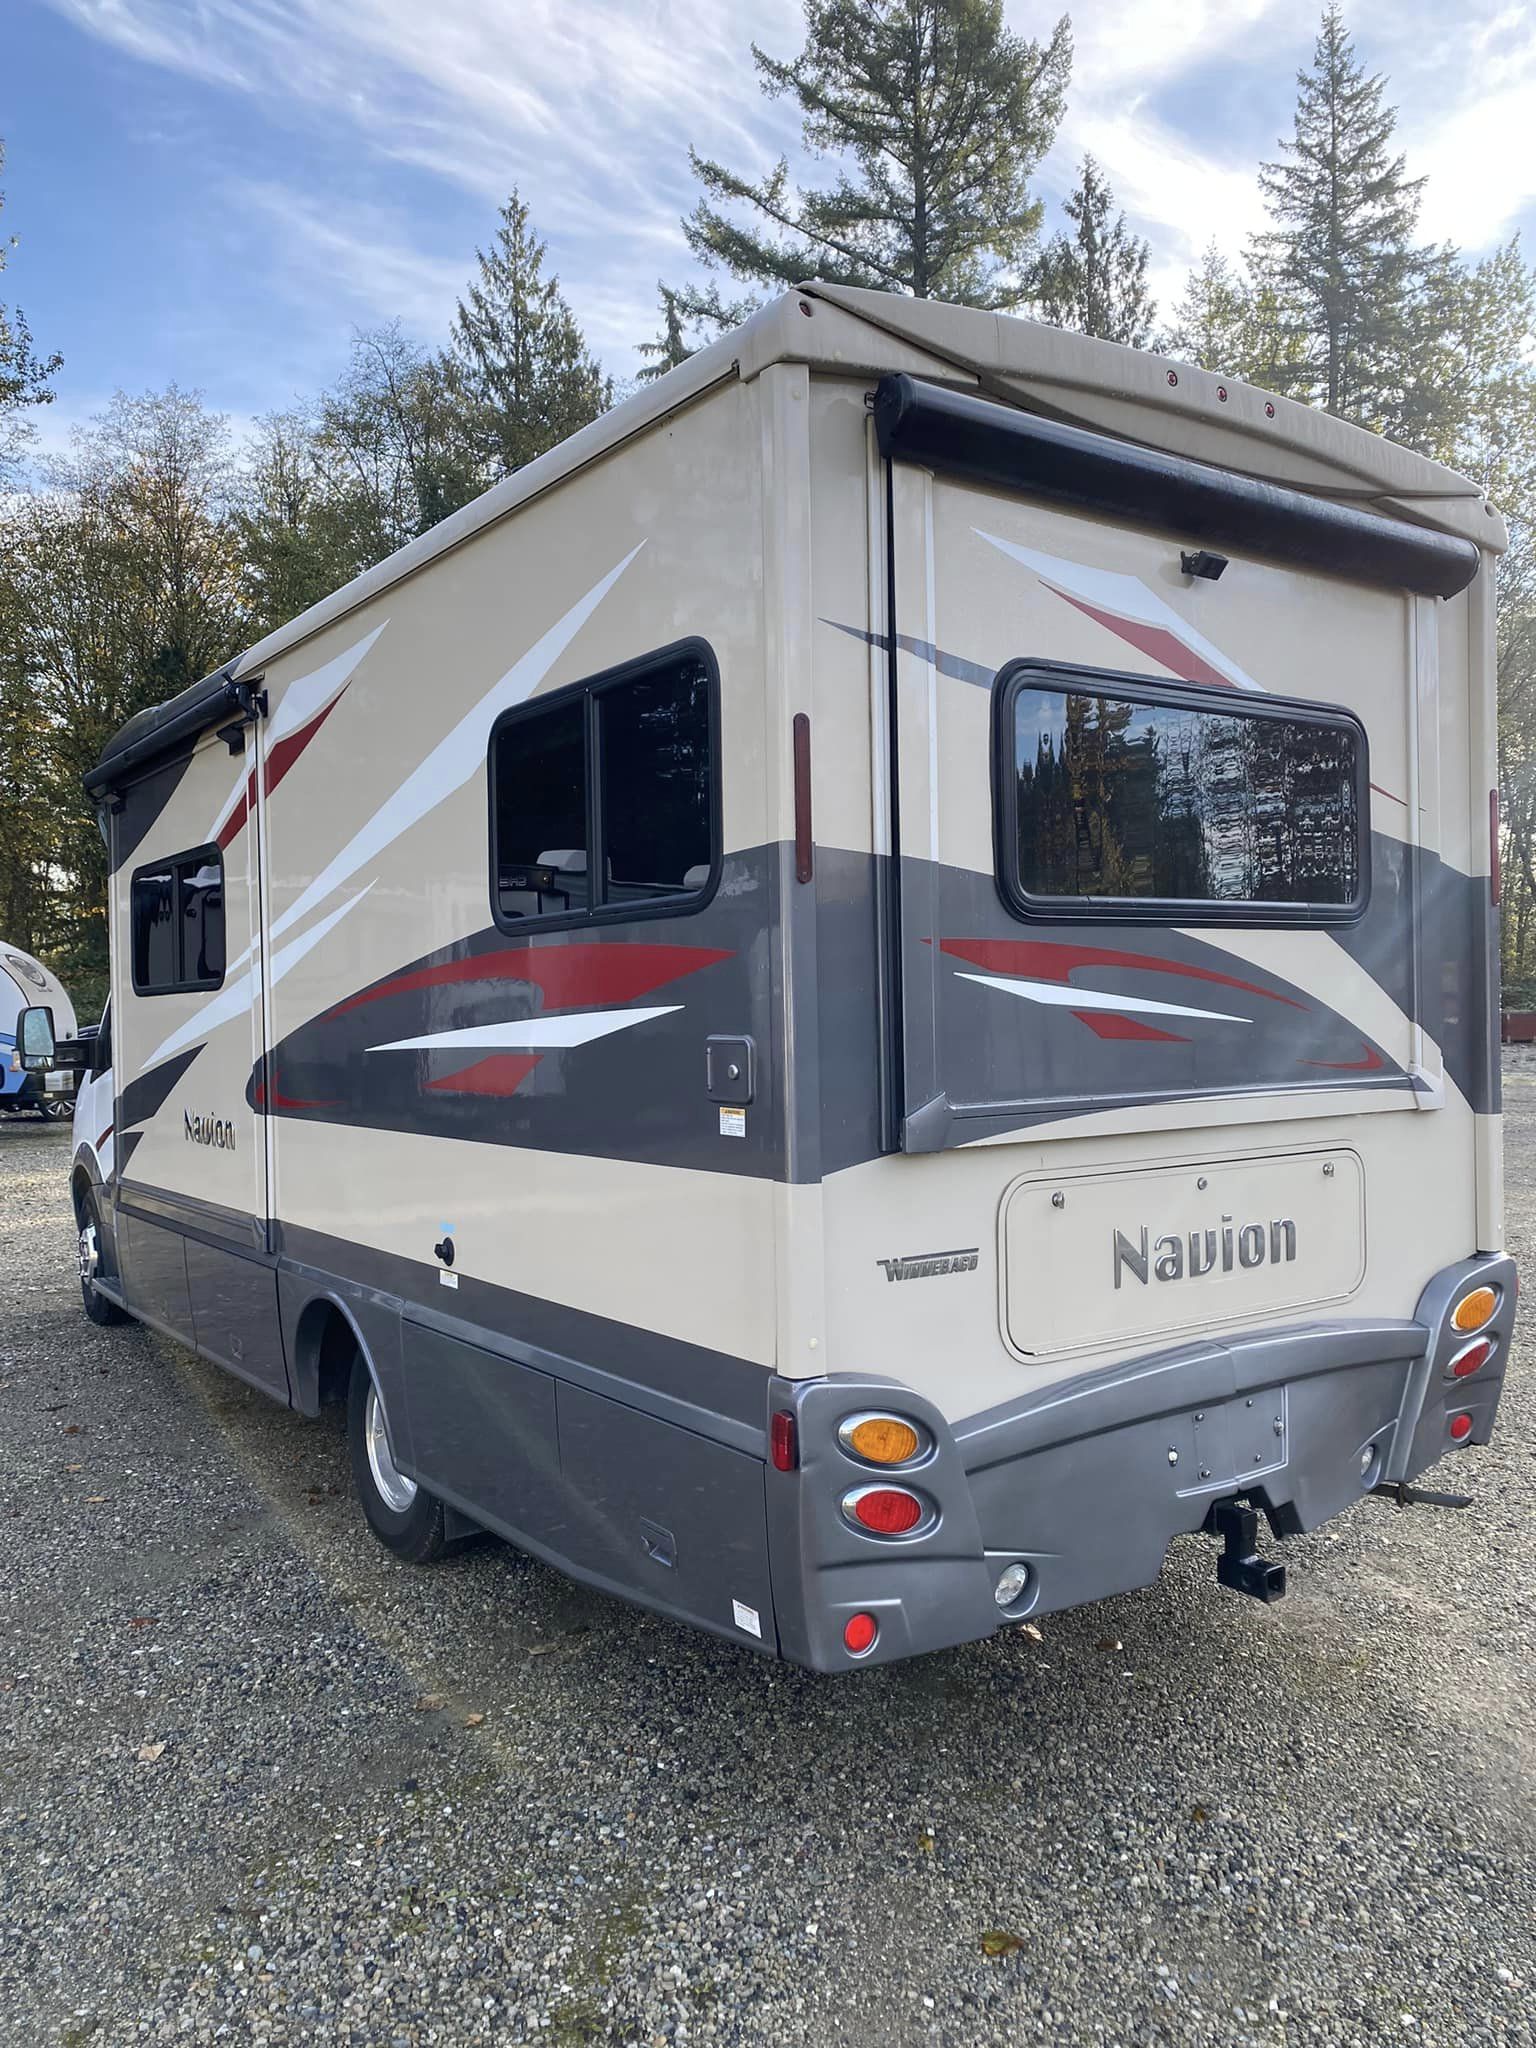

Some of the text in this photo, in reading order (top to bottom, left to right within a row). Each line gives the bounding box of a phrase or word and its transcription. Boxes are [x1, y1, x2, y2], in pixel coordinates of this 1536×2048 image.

[184, 1107, 236, 1150] Navion
[876, 1247, 980, 1282] WINNEBAGO
[1113, 1214, 1298, 1290] Navion
